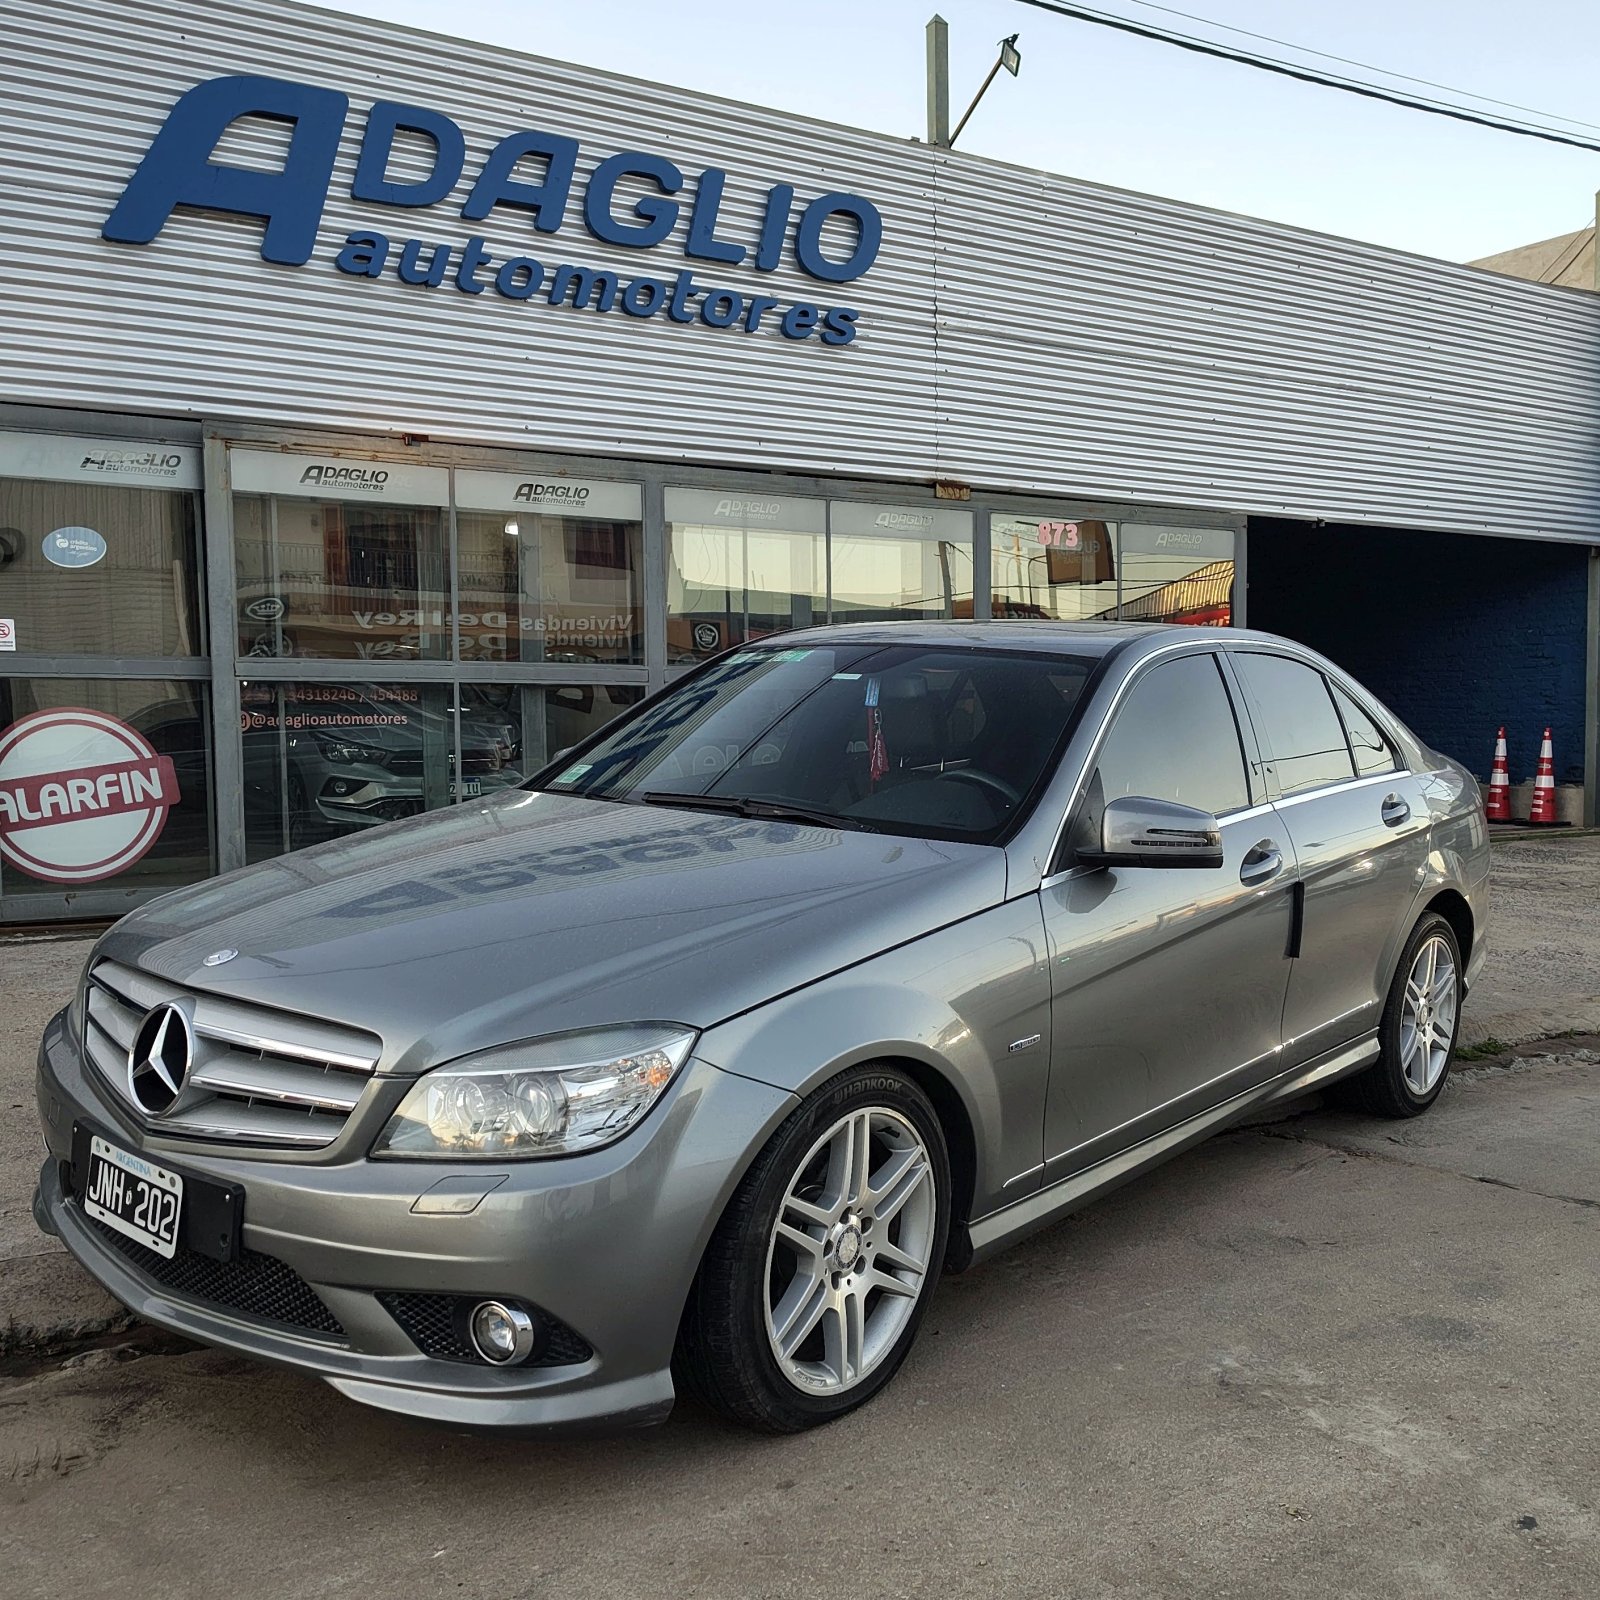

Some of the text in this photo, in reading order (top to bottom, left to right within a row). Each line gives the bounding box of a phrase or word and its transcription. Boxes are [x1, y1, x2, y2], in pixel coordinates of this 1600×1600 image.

[101, 74, 882, 282] ADAGLIO
[335, 229, 860, 346] automotores
[300, 465, 389, 484] ADAGLIO
[322, 479, 385, 491] automotores
[513, 483, 590, 501] ADAGLIO
[531, 496, 586, 507] automotores
[714, 499, 782, 515] ADAGLIO
[1037, 521, 1078, 547] 873
[1155, 532, 1203, 546] ADAGLIO
[115, 1151, 152, 1177] ARGENTINA
[88, 1160, 176, 1241] JNH 202
